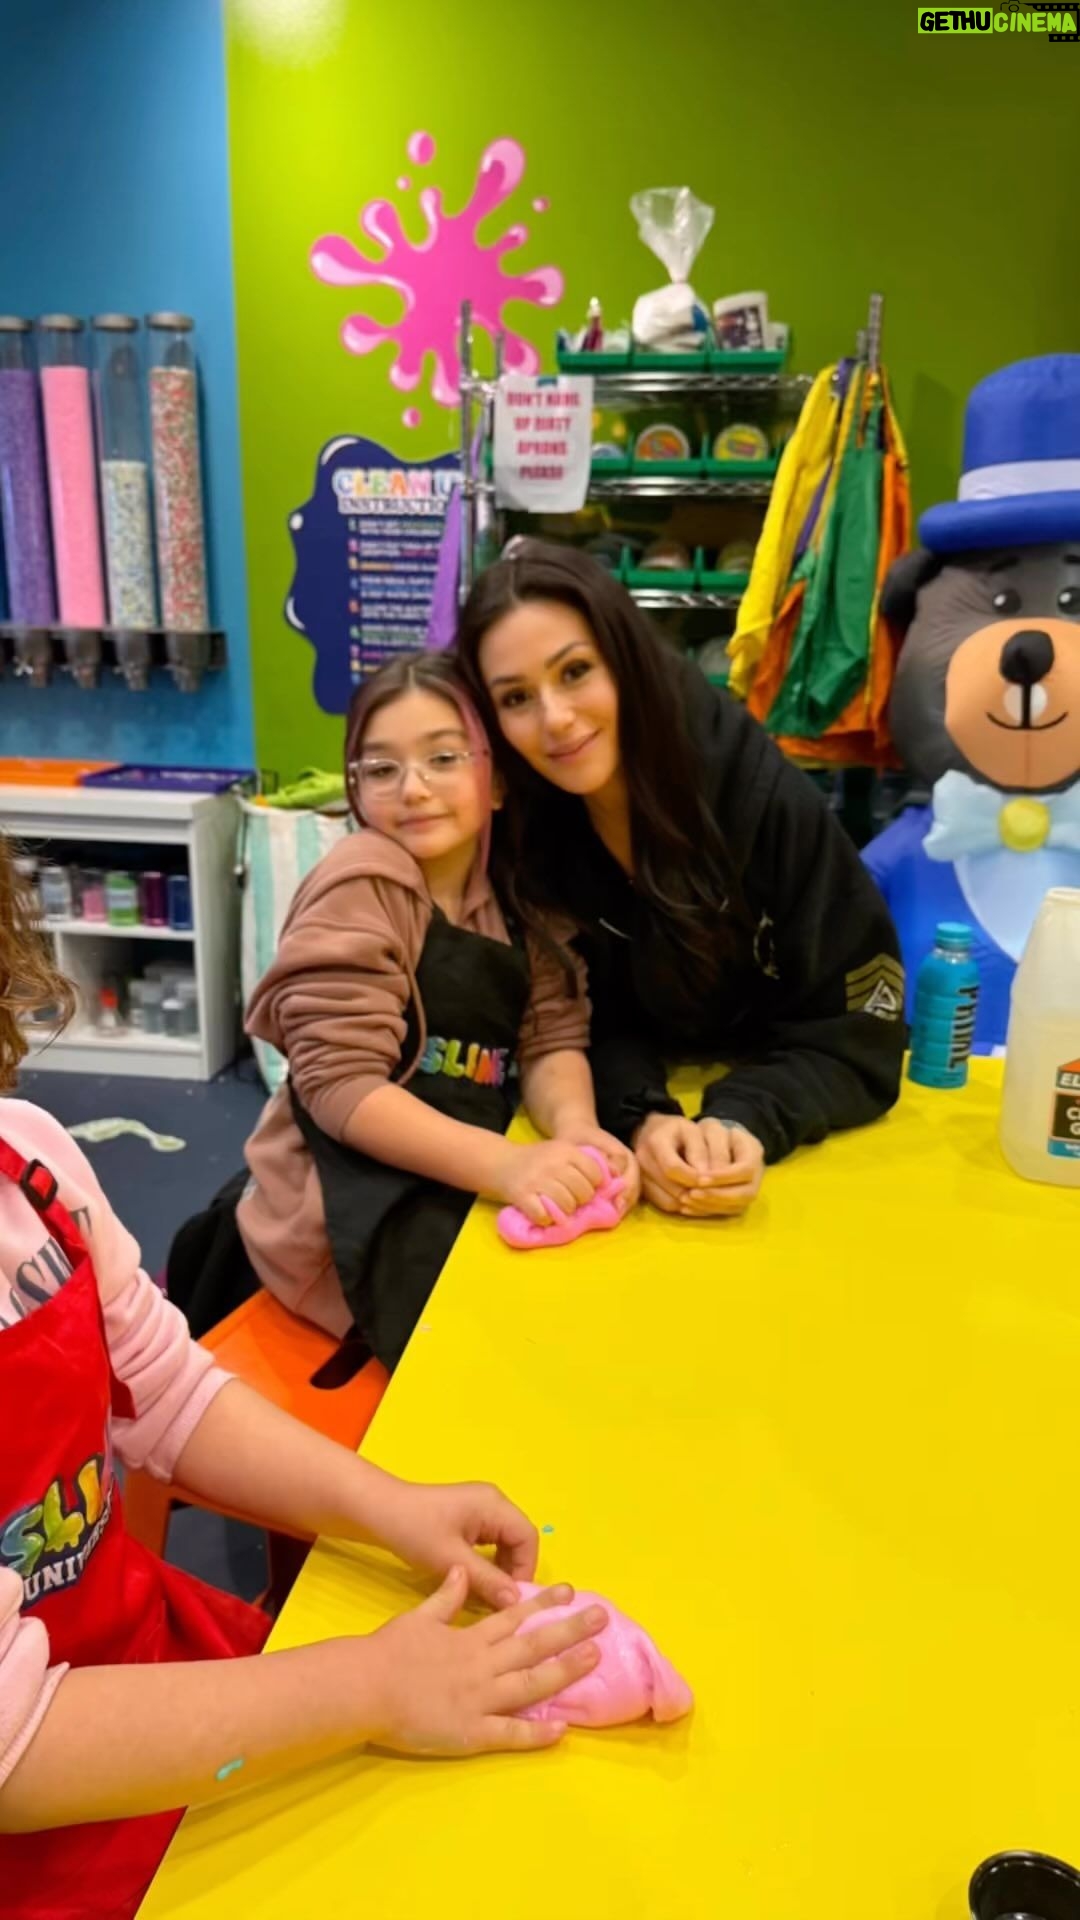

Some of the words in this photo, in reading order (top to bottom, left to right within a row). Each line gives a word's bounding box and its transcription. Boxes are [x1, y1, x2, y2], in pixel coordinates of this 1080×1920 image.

[332, 468, 433, 497] CLEAN
[520, 465, 563, 479] PLEASE
[949, 985, 979, 1069] PRIME
[421, 1036, 509, 1088] SLIME
